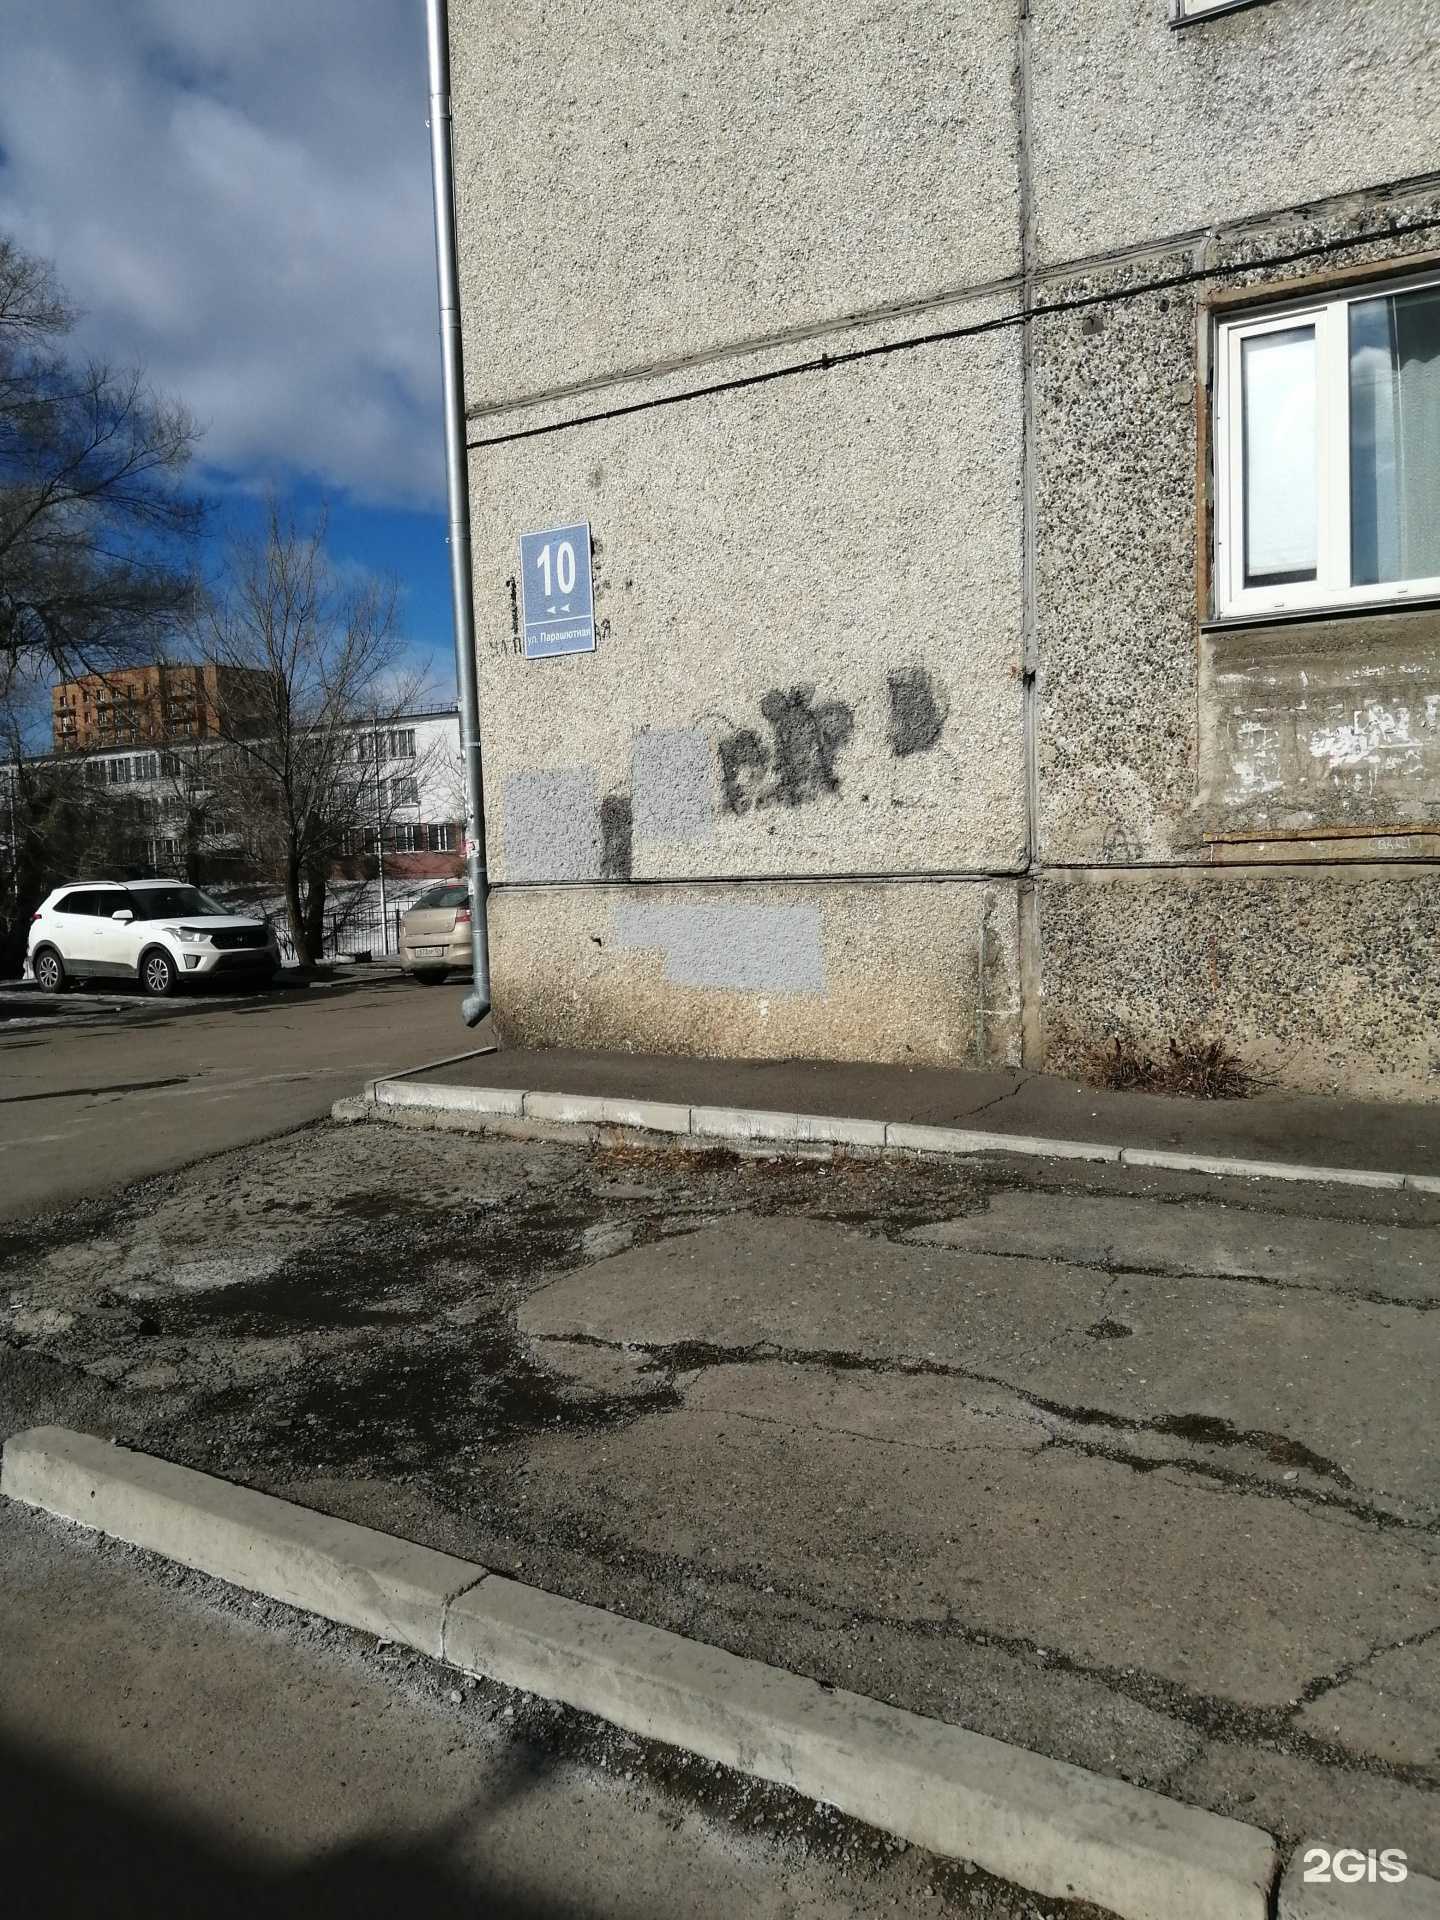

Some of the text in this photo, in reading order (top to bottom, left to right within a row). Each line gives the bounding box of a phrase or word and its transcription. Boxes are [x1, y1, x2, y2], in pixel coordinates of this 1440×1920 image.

[537, 541, 576, 596] 10
[527, 634, 539, 646] ул.
[540, 629, 592, 643] Парашютная
